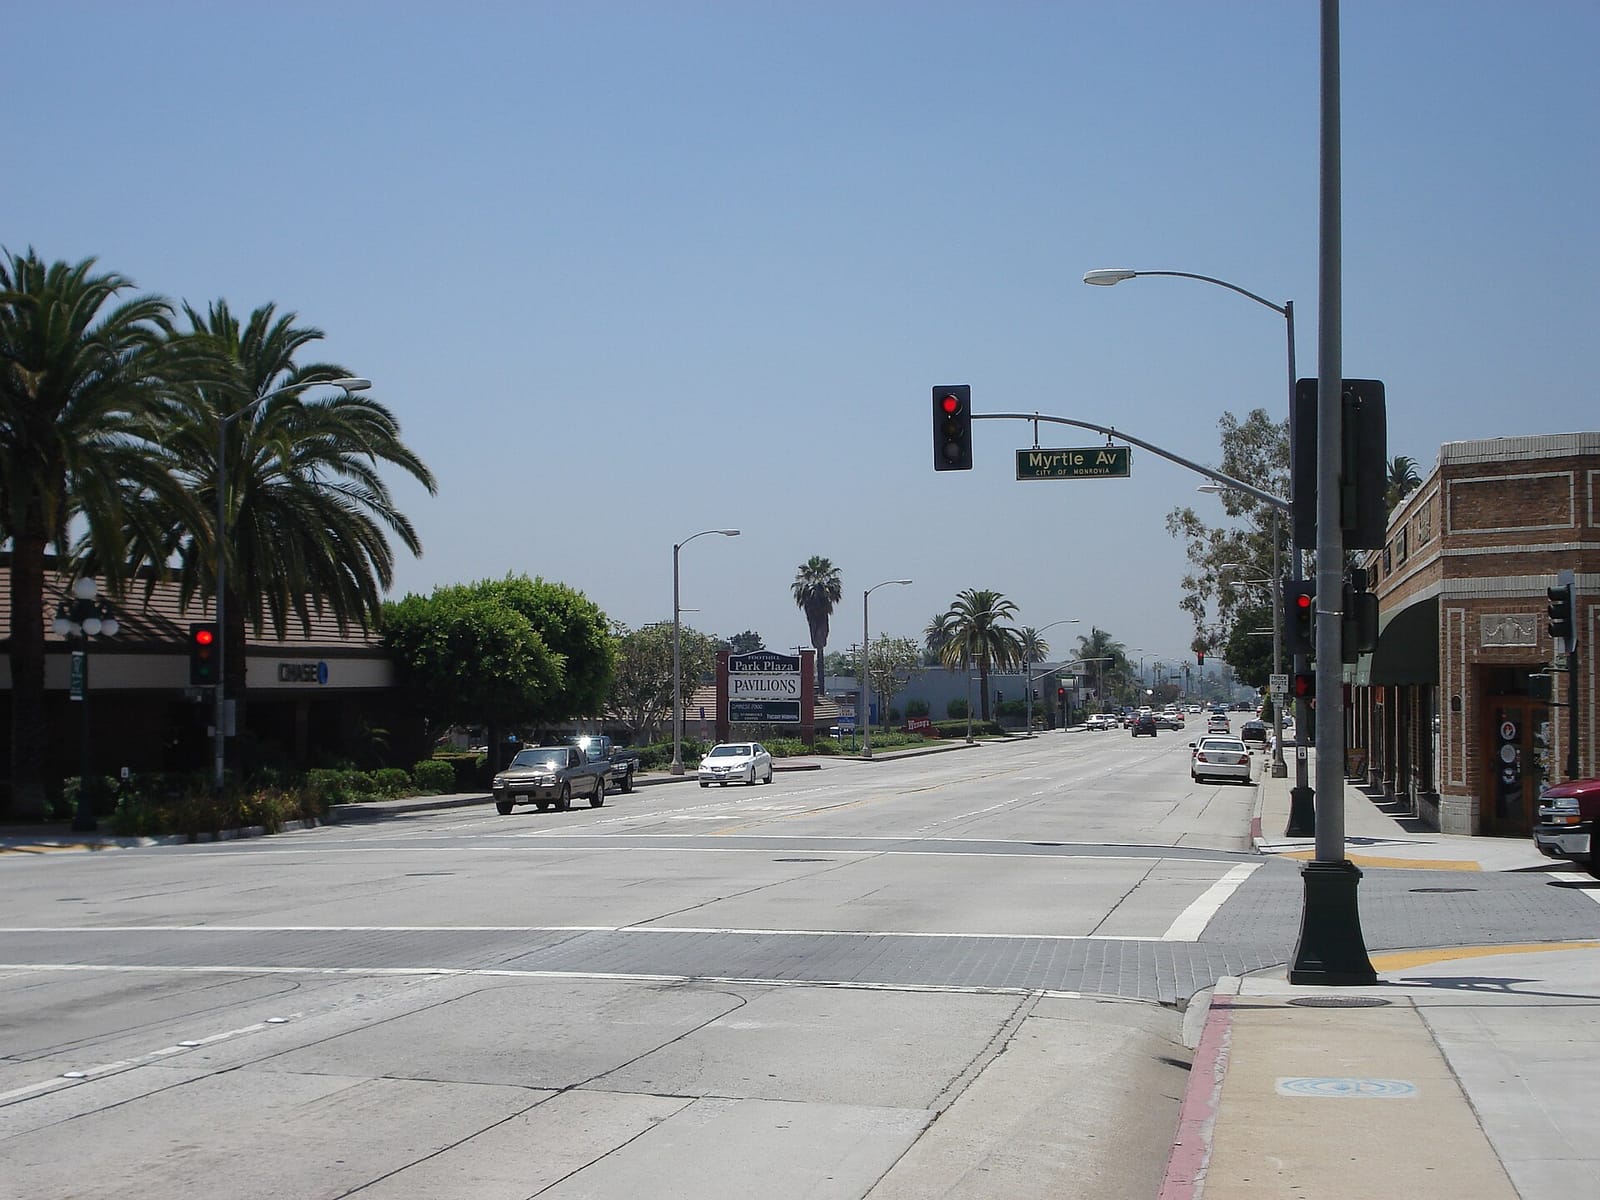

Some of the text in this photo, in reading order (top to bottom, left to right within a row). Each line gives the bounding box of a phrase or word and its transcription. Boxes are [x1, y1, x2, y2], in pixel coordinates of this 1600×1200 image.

[1029, 451, 1117, 469] Myrtle Av
[278, 663, 318, 682] CHASE
[735, 661, 794, 671] Park Plaza
[734, 679, 796, 694] PAVILIONS
